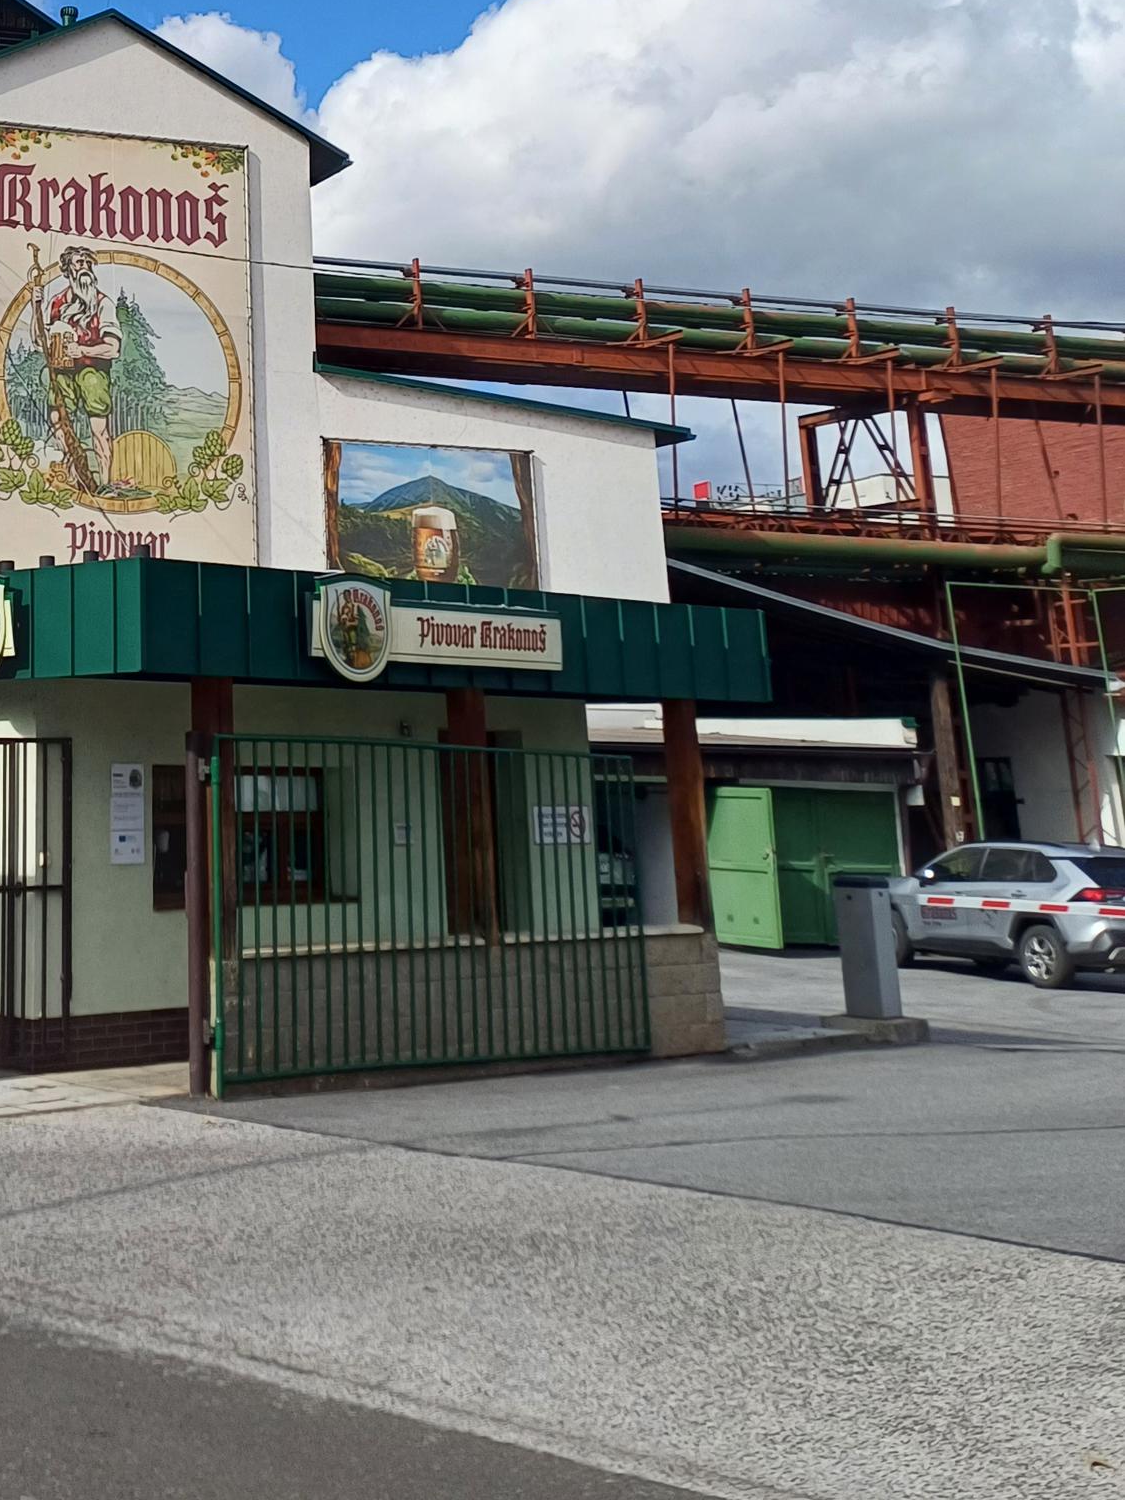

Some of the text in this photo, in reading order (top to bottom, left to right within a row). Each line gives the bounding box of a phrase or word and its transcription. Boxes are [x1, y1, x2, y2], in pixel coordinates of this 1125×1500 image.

[64, 521, 170, 563] Pivovar
[417, 616, 547, 653] Pivovar Krakonoš
